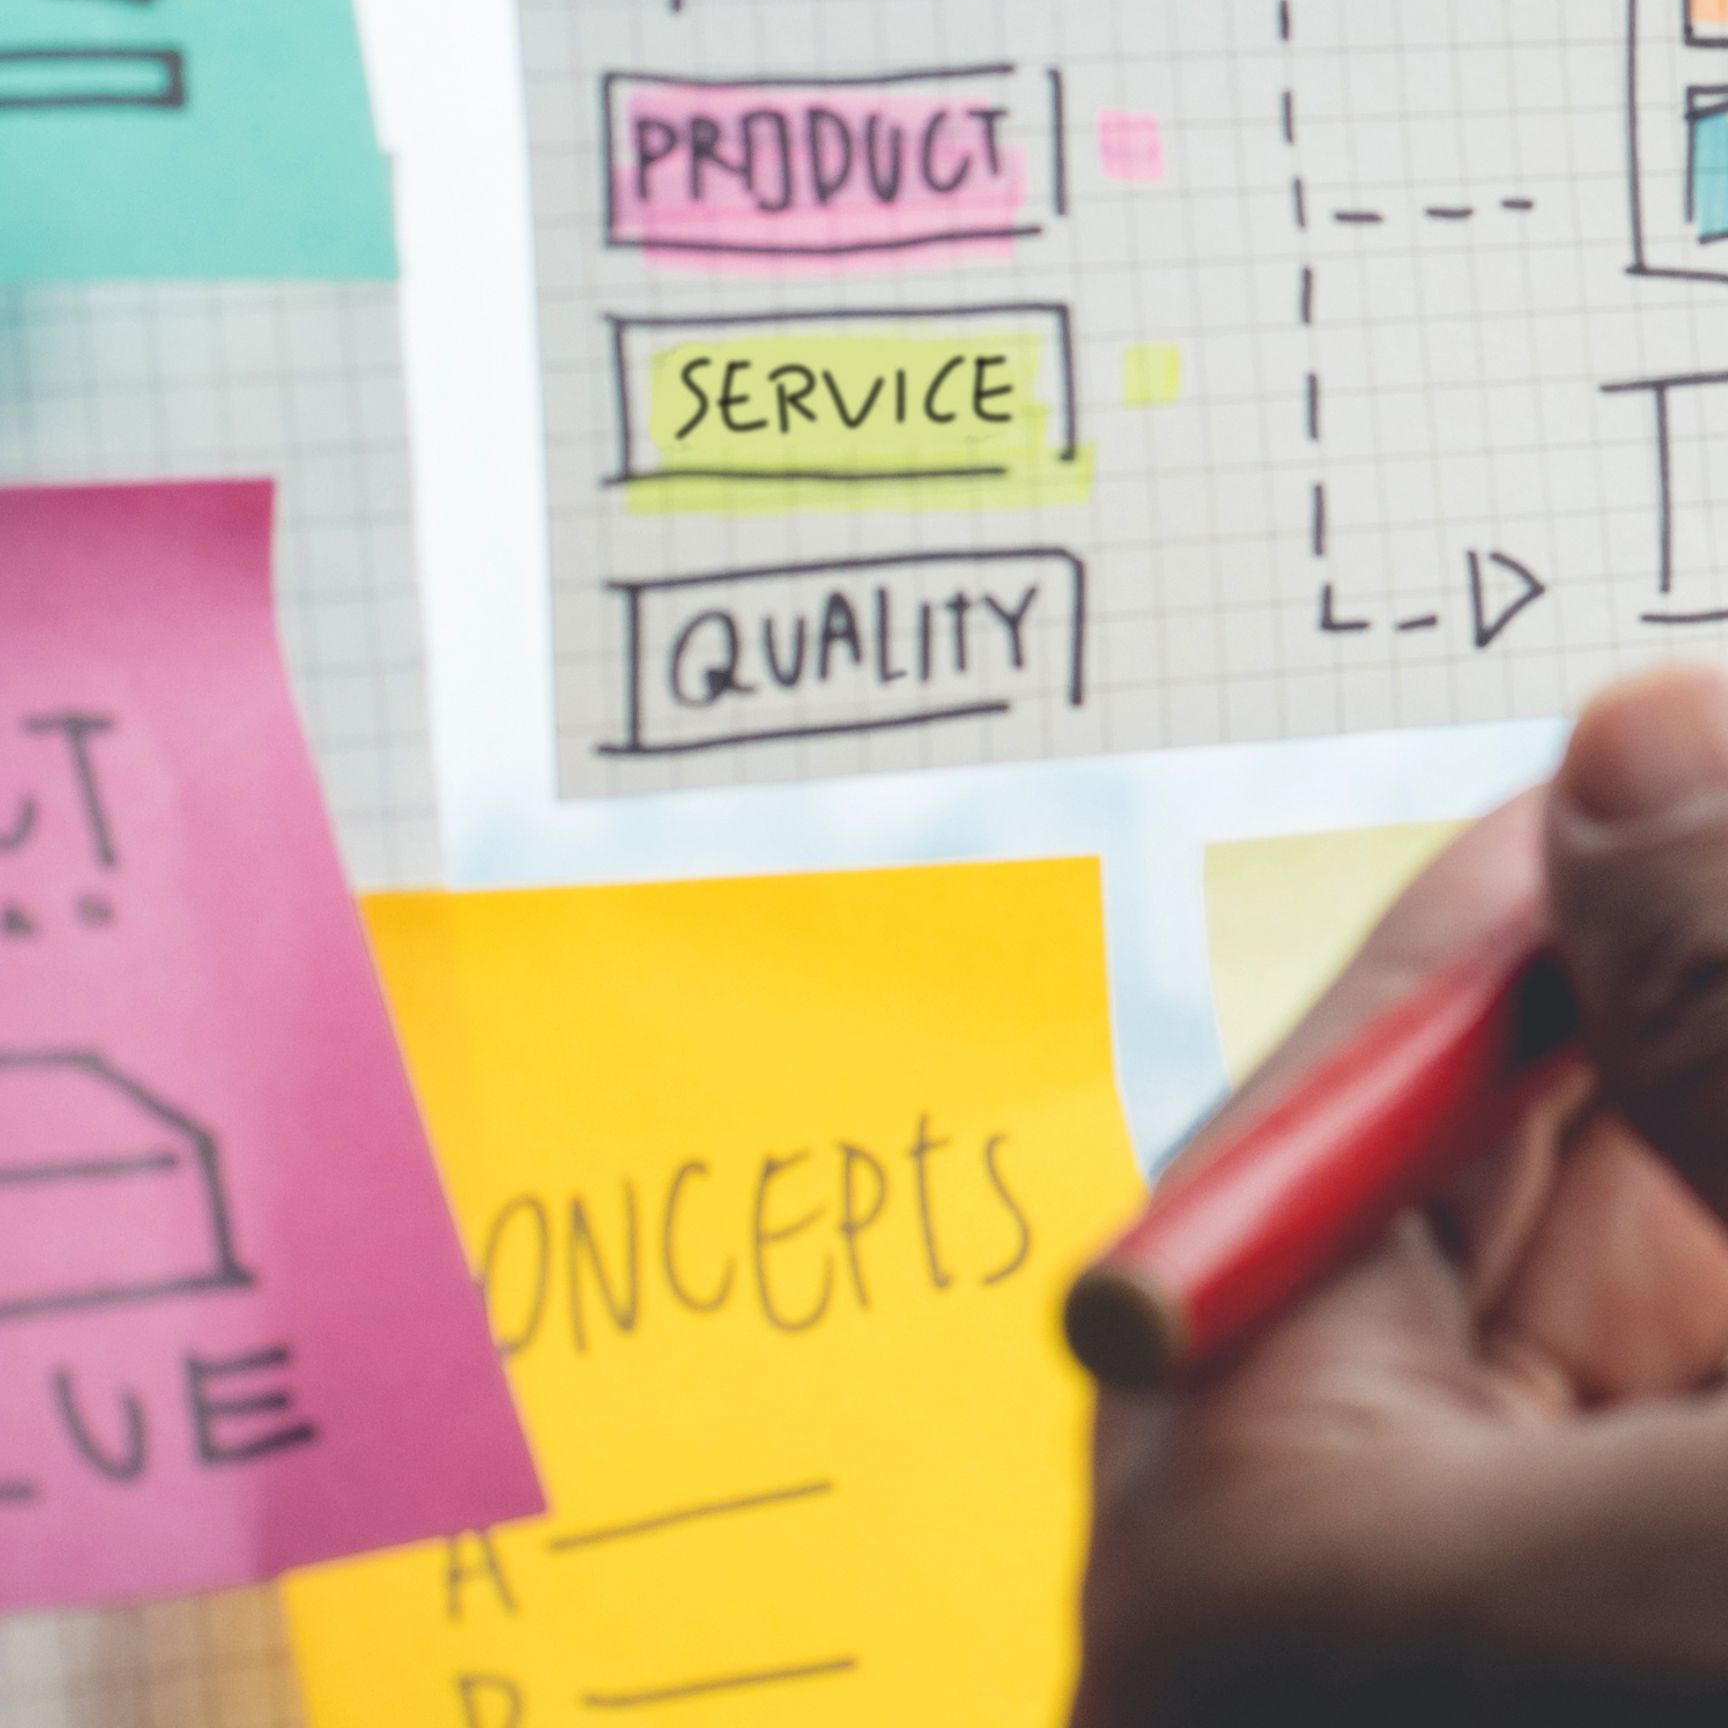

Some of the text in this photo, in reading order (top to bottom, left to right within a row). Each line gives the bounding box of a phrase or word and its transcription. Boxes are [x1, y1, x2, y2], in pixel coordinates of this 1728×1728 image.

[636, 108, 1003, 212] PRODUCT
[674, 354, 1014, 441] SERVICE
[671, 586, 1039, 708] QUALITY
[466, 1113, 1031, 1358] ONCEPTS
